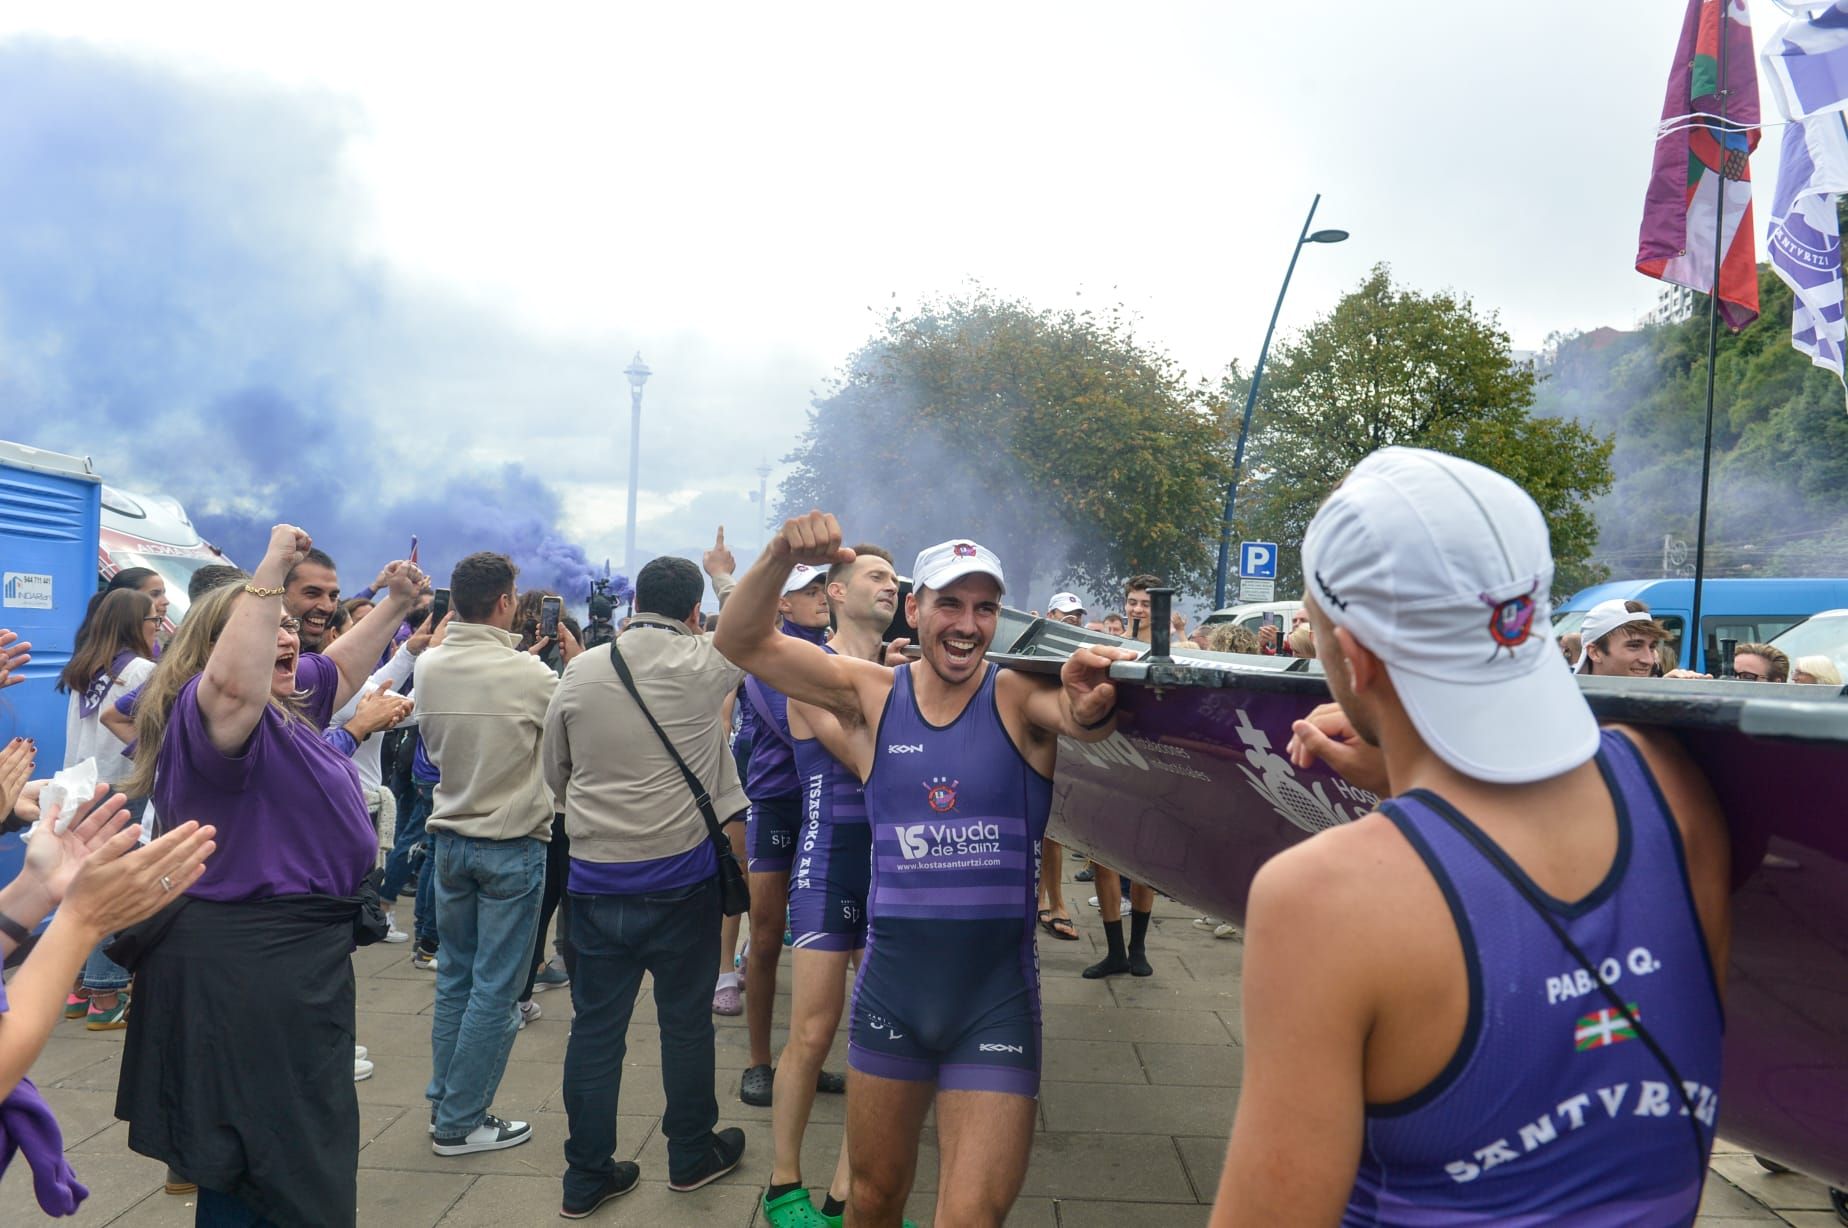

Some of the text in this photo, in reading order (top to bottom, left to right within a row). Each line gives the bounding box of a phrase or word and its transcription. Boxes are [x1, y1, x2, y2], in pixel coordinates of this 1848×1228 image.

[1247, 546, 1270, 574] P
[798, 774, 823, 889] ITSASOKO AMA
[929, 820, 999, 843] Viuda
[931, 842, 1000, 856] de Sainz
[896, 858, 1001, 871] www.kostasanturtzi.com
[1546, 947, 1661, 1005] PABO Q.
